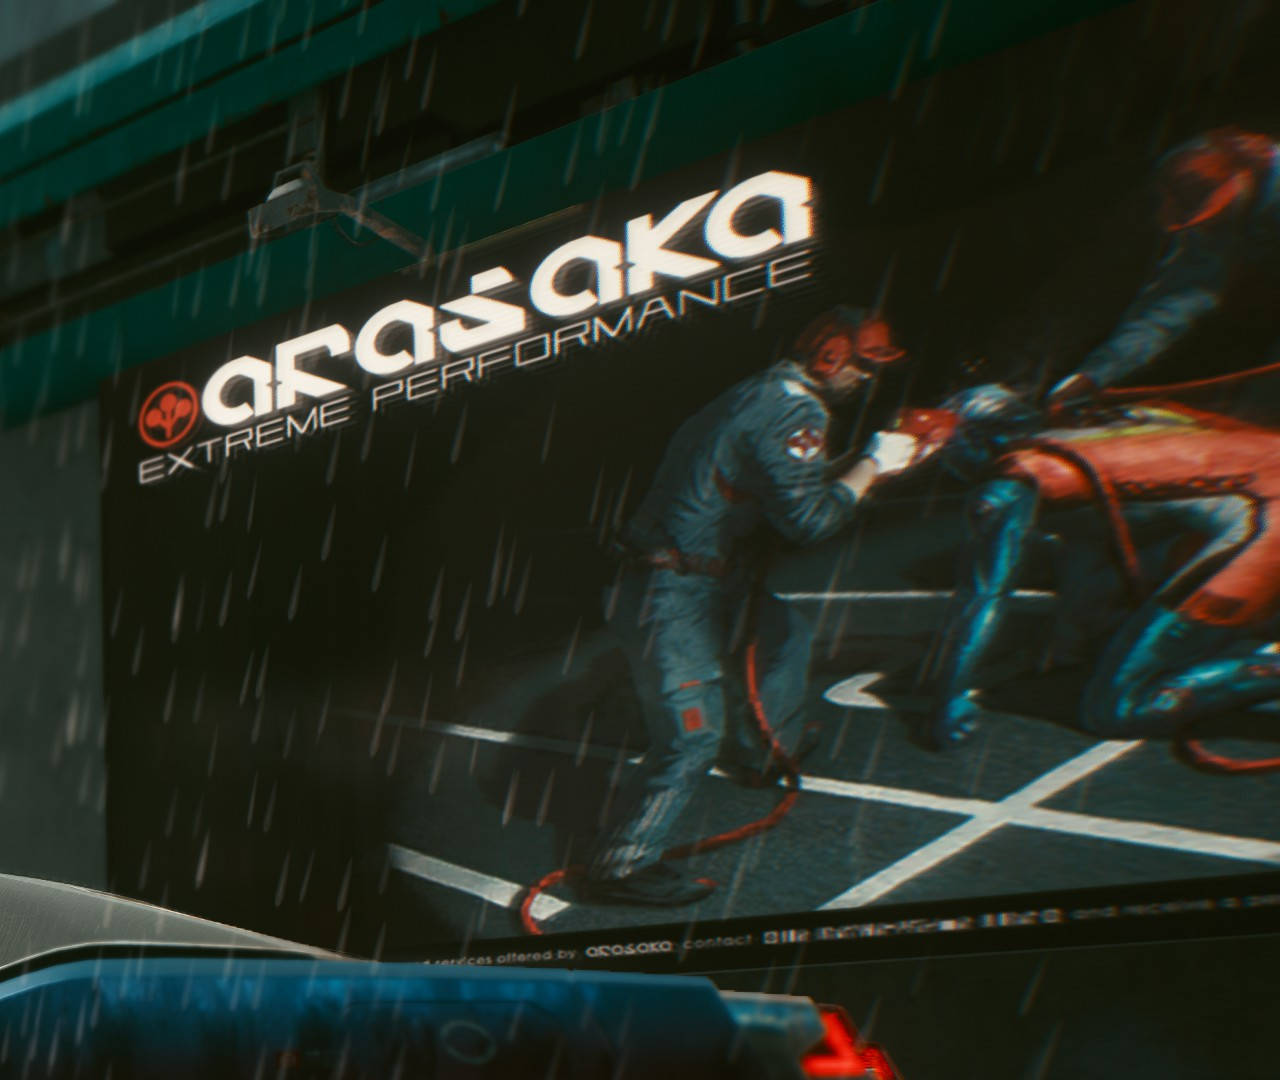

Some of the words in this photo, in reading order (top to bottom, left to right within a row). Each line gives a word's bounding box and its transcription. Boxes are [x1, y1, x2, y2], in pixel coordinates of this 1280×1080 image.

[139, 396, 352, 484] EXTREME
[372, 249, 812, 412] PERFORMANCE
[496, 949, 553, 965] offered
[557, 948, 577, 962] by
[682, 934, 753, 950] contact
